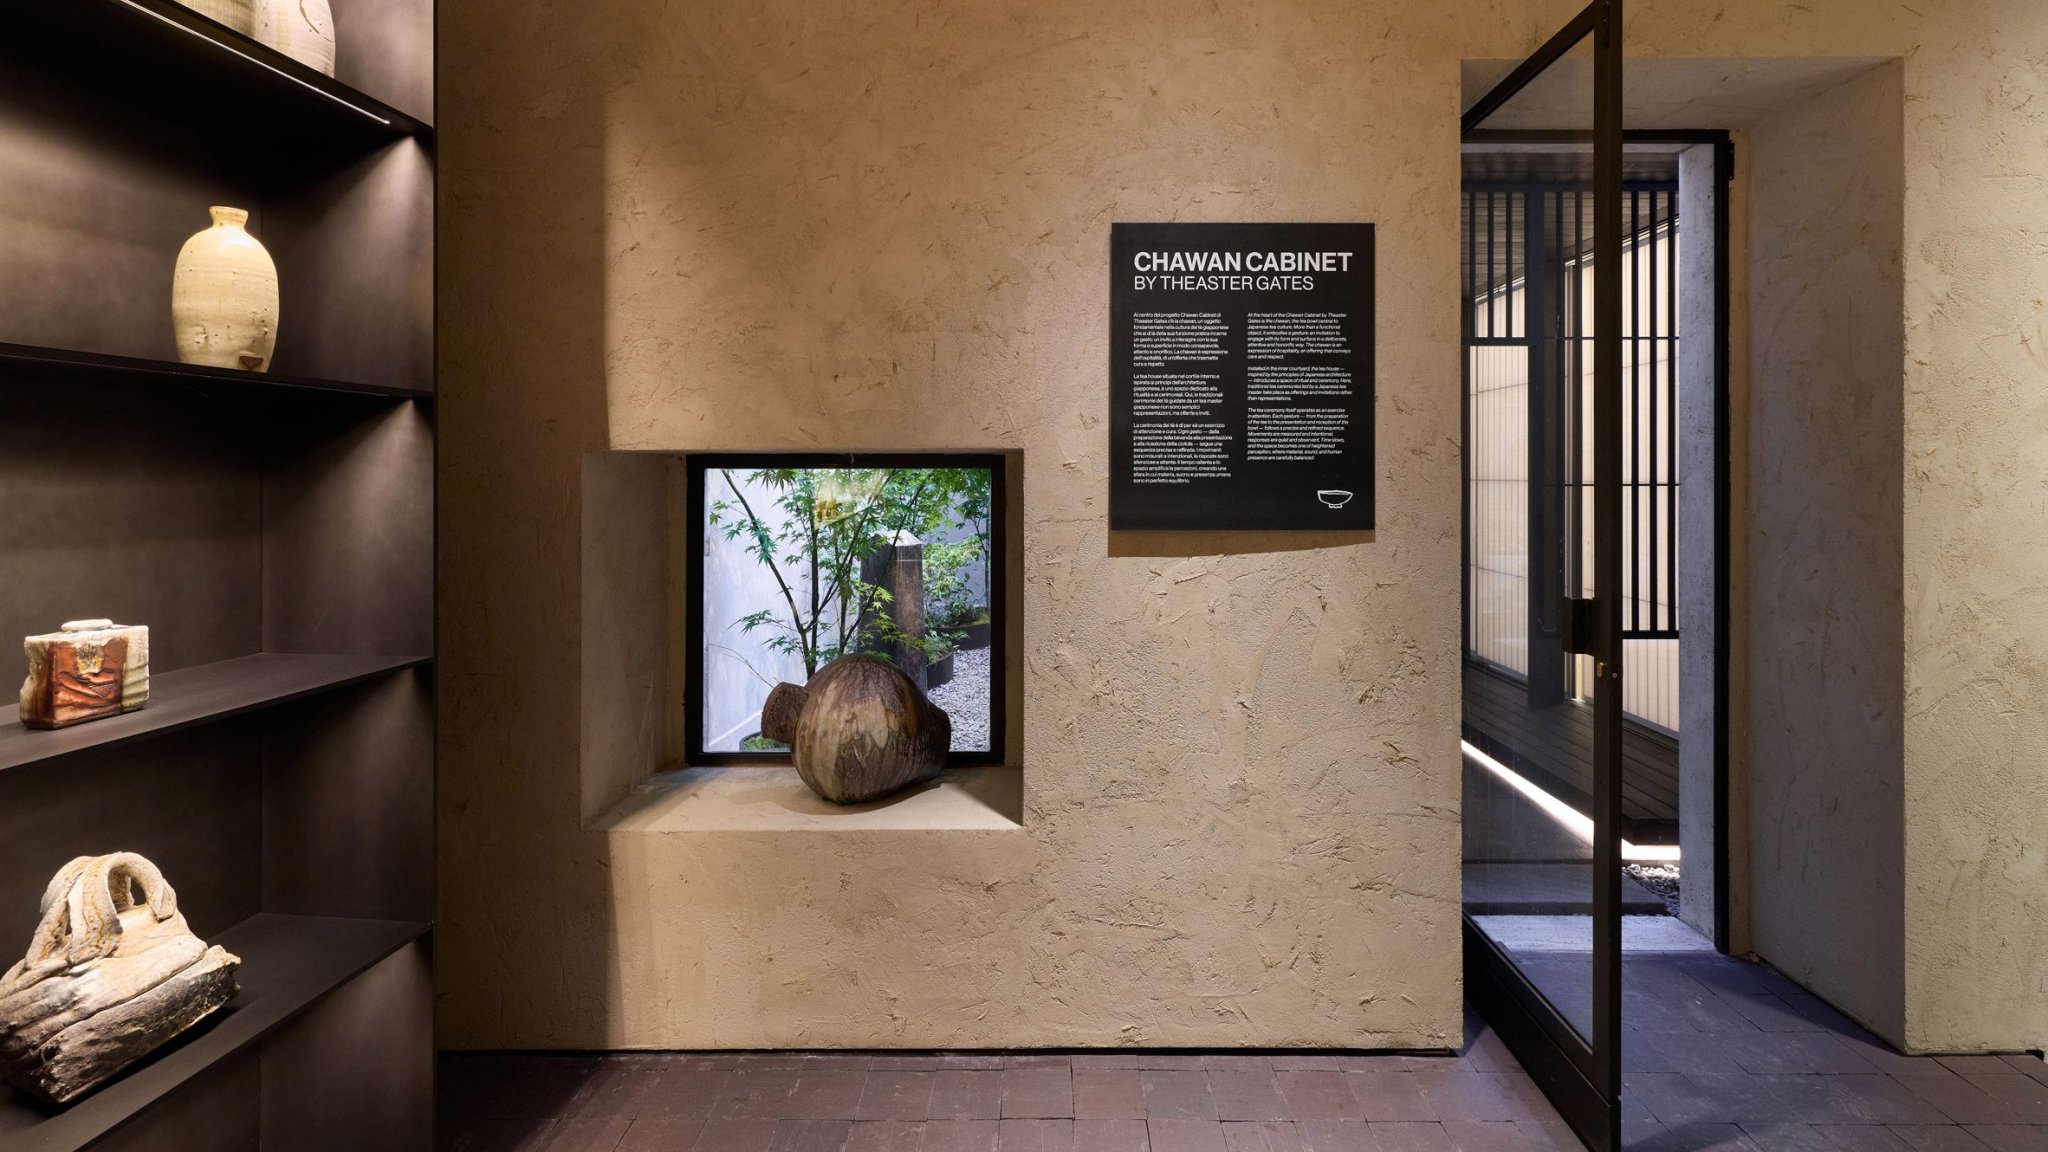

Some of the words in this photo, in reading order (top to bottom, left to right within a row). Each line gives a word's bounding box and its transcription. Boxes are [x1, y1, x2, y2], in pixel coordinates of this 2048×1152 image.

[1134, 252, 1241, 271] CHAWAN
[1246, 252, 1353, 271] CABINET
[1134, 276, 1157, 291] BY
[1160, 276, 1253, 291] THEASTER
[1256, 276, 1314, 291] GATES
